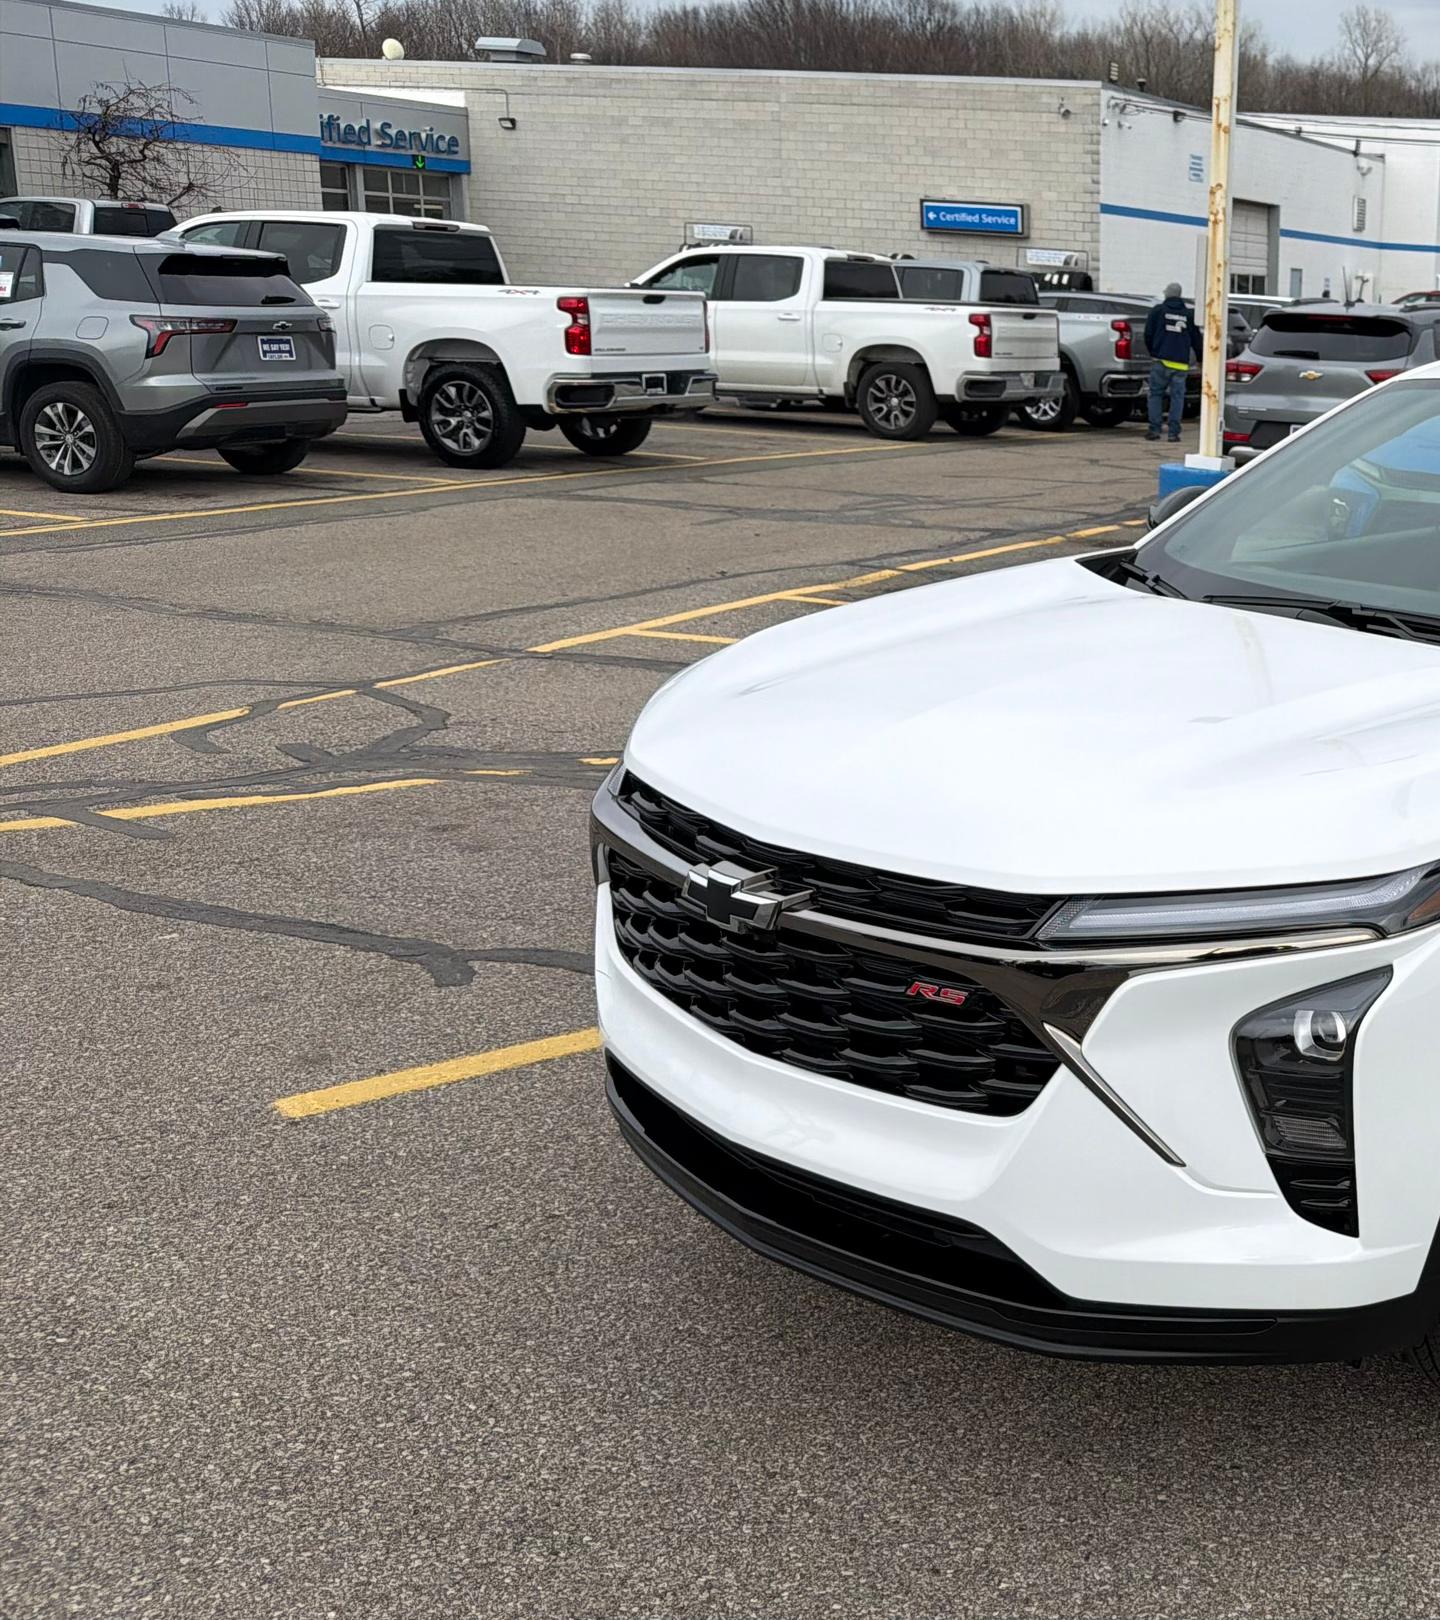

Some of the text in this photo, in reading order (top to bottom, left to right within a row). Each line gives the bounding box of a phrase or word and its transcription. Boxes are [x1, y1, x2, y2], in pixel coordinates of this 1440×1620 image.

[379, 121, 459, 155] Service
[939, 211, 1016, 225] Certified Service
[906, 981, 969, 1005] RS
